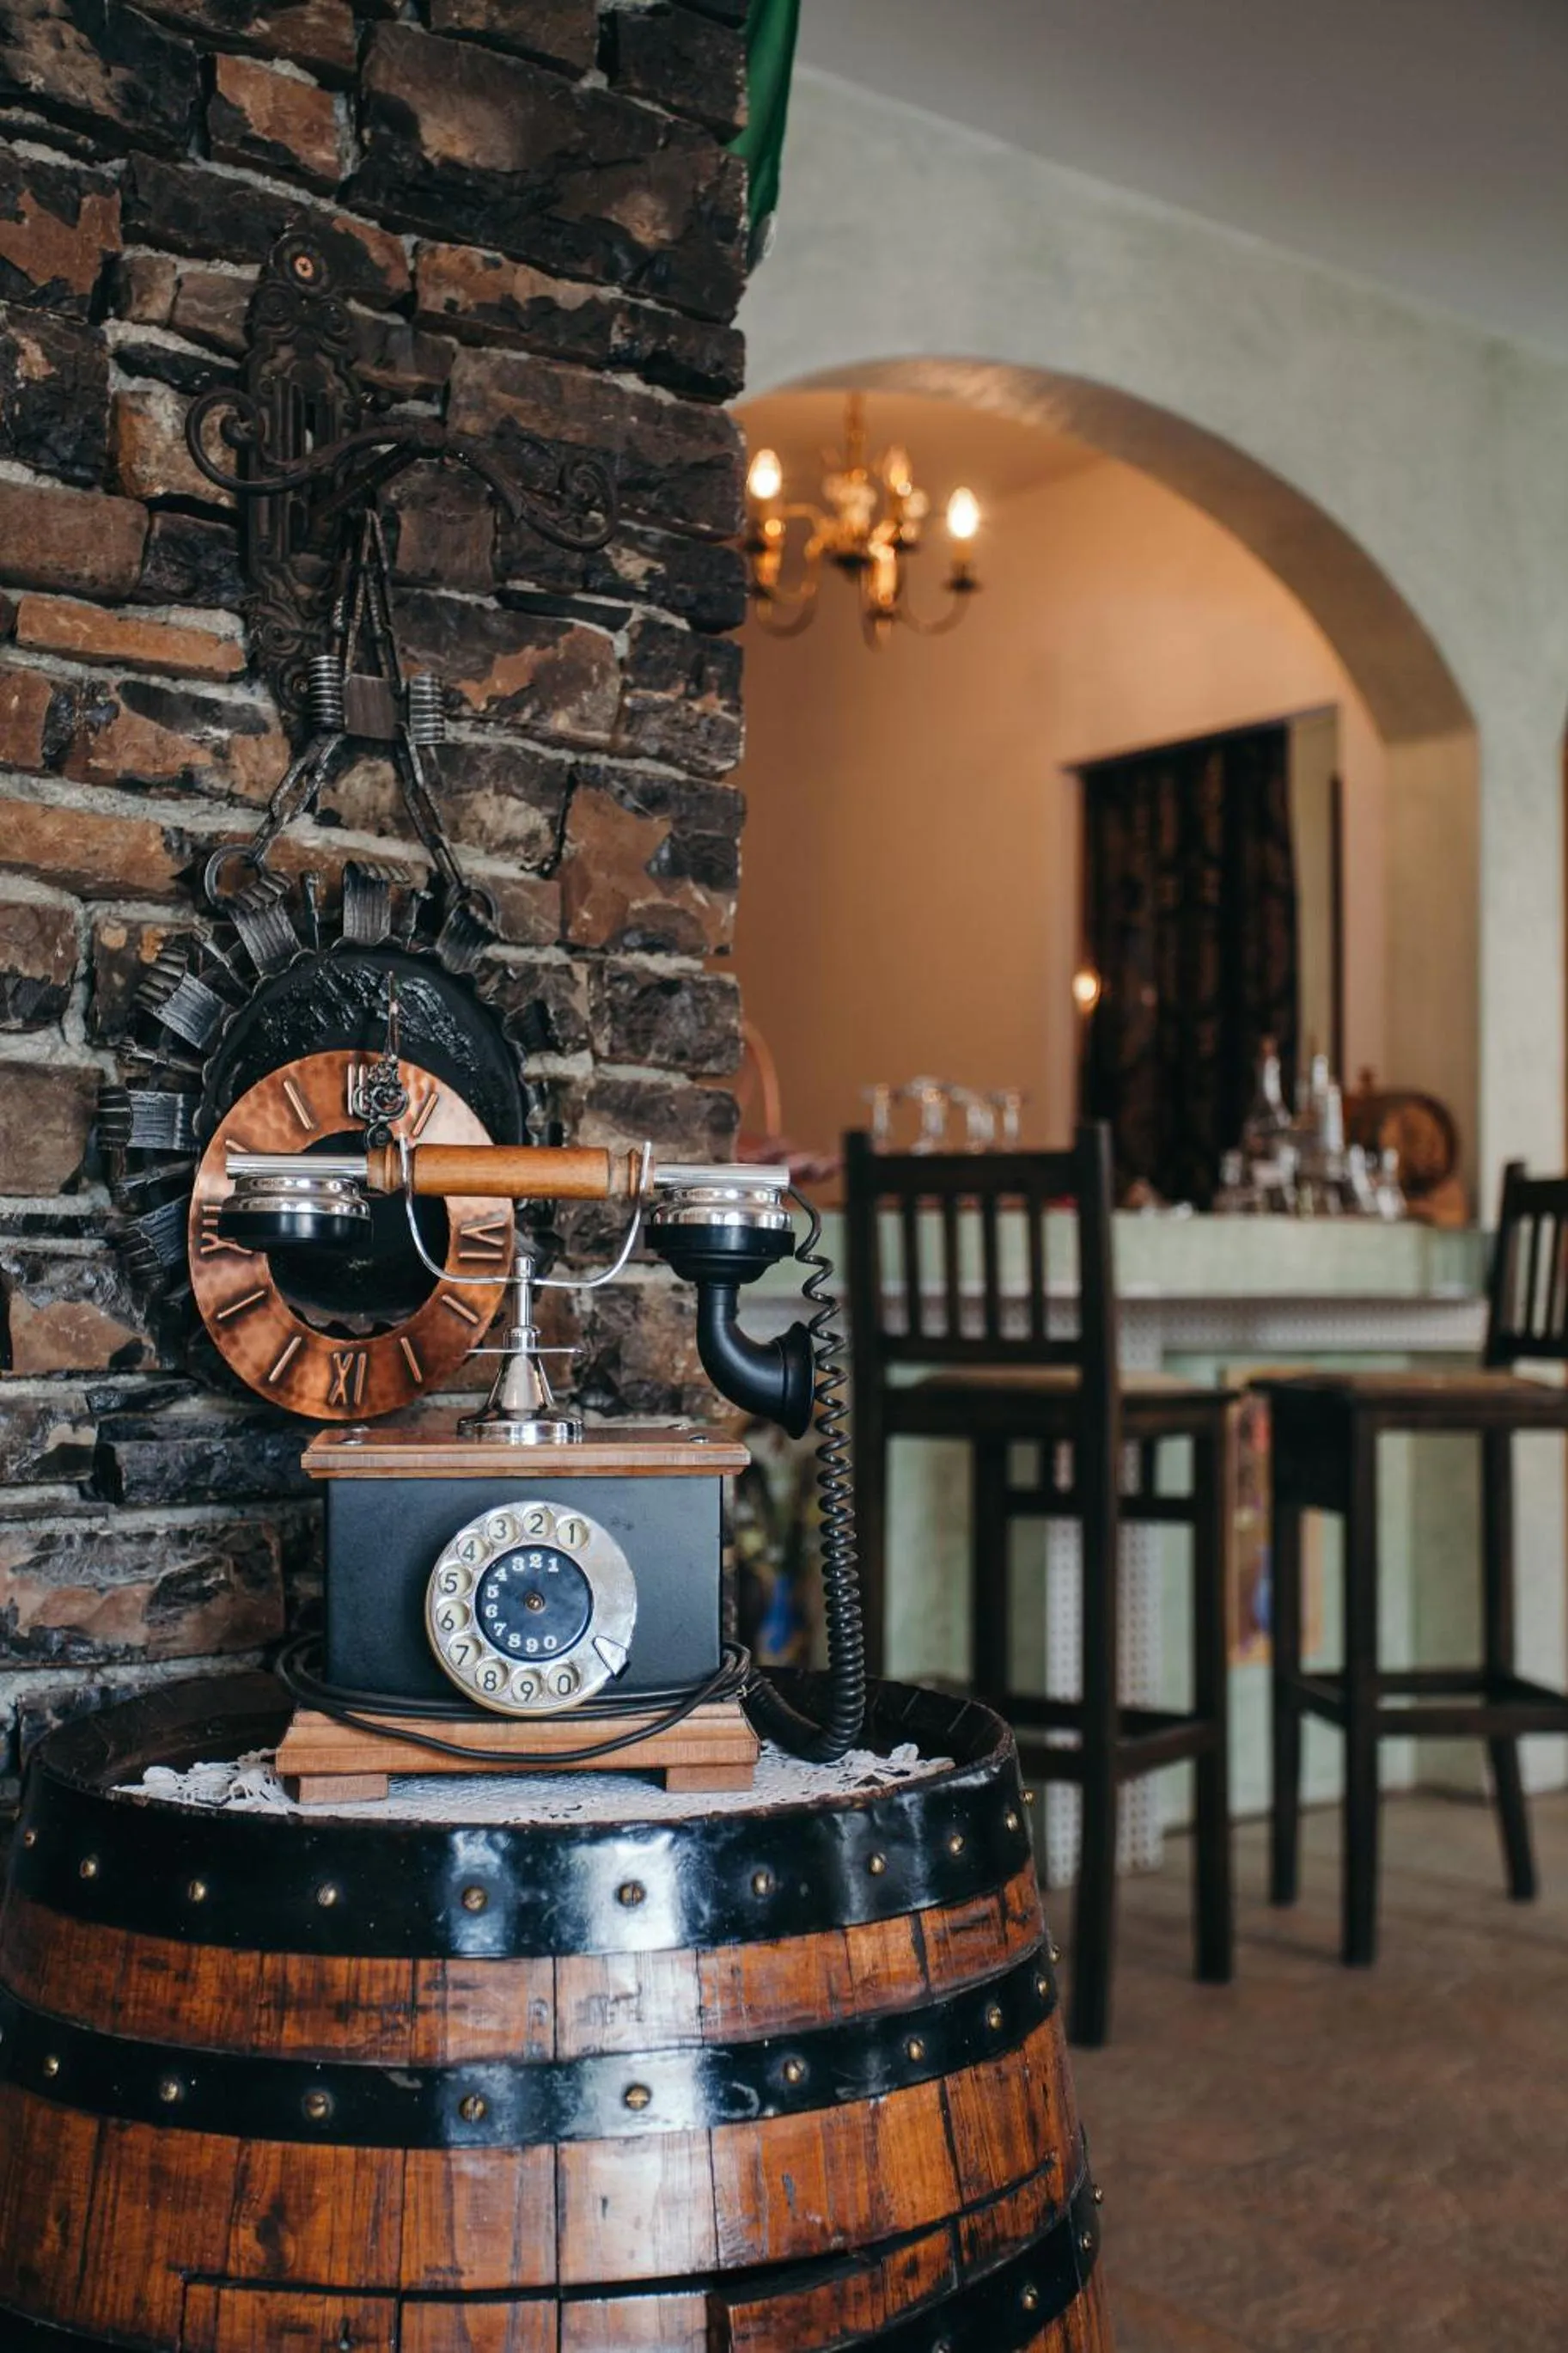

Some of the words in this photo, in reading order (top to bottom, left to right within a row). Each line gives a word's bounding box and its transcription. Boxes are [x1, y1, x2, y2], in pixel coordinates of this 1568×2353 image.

[495, 1519, 507, 1539] 3
[530, 1513, 543, 1534] 2
[568, 1523, 575, 1544] 1
[462, 1540, 476, 1562] 4
[511, 1556, 525, 1573] 3
[528, 1553, 543, 1569] 2
[547, 1557, 559, 1573] 1
[444, 1573, 457, 1592] 5
[493, 1567, 508, 1582] 4
[486, 1585, 499, 1598] 5
[485, 1604, 498, 1618] 6
[441, 1610, 455, 1631] 6
[493, 1622, 507, 1636] 7
[507, 1633, 522, 1648] 8
[525, 1637, 539, 1653] 9
[543, 1635, 558, 1650] 0
[456, 1645, 469, 1665] 7
[483, 1670, 497, 1692] 8
[558, 1675, 571, 1696] 0
[521, 1681, 534, 1702] 9
